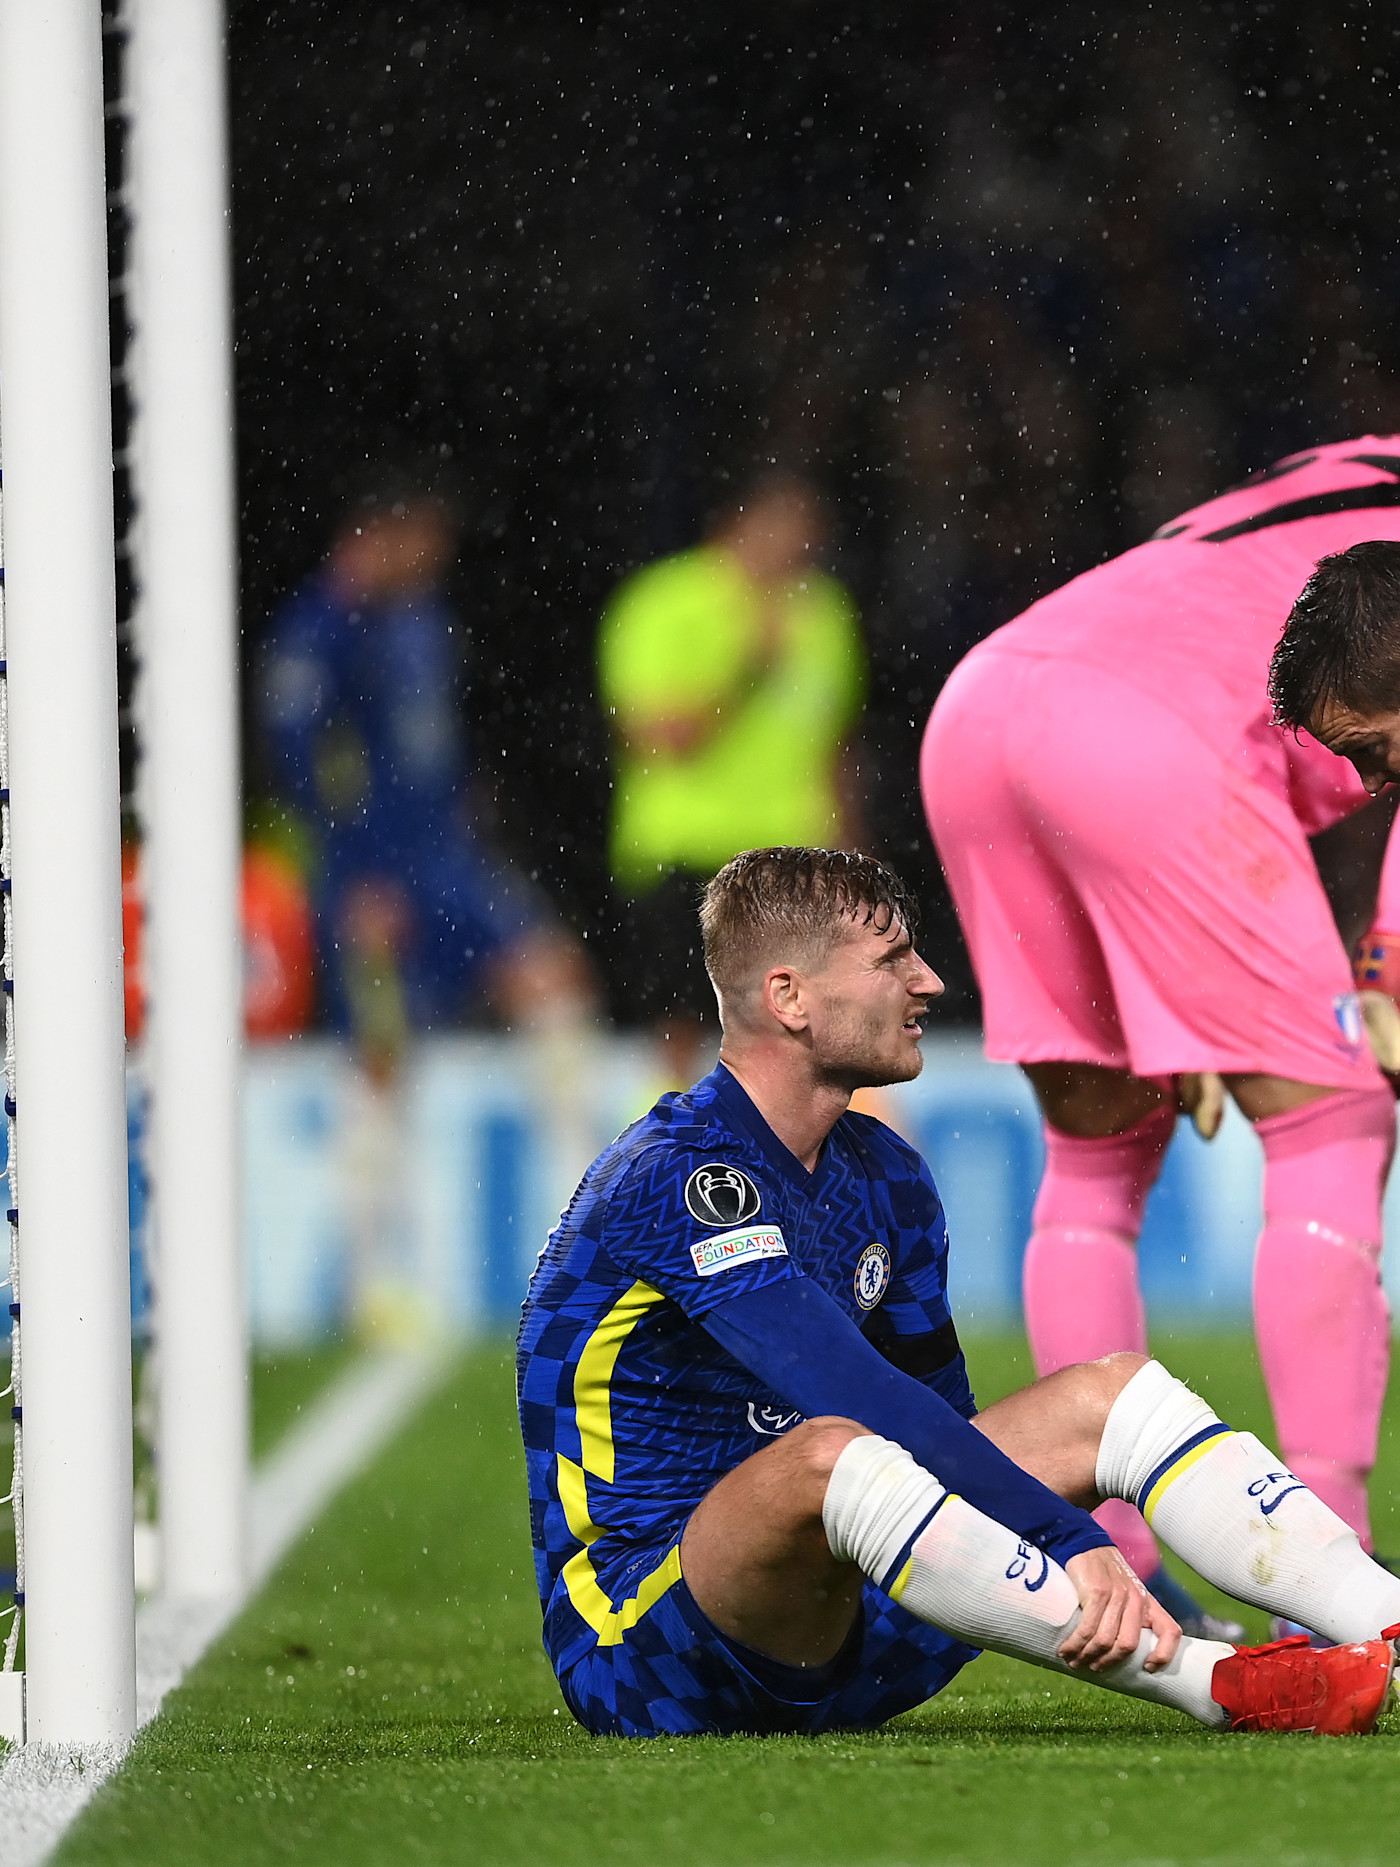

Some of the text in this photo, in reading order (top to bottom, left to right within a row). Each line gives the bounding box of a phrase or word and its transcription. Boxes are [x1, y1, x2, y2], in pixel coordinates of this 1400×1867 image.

[694, 1242, 713, 1255] UEFA
[696, 1235, 784, 1267] FOUNDATION
[862, 1246, 887, 1262] CHELSEA
